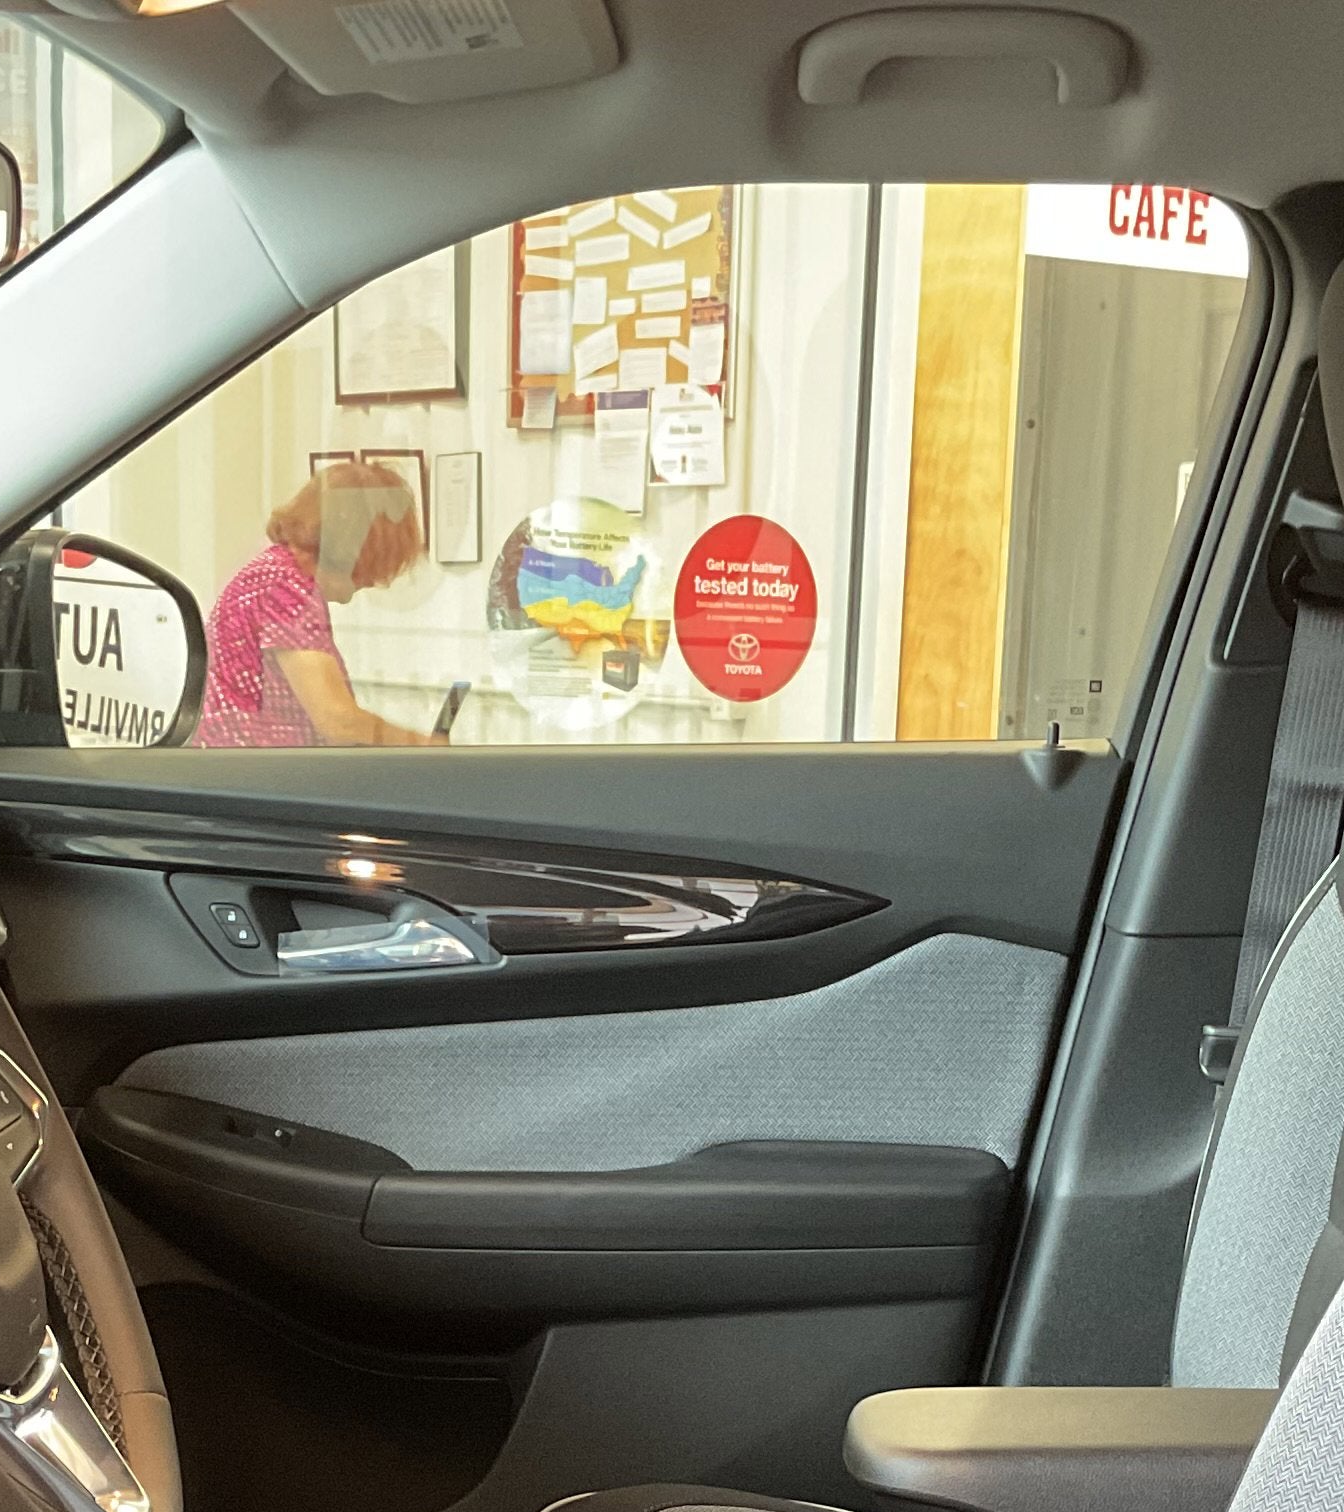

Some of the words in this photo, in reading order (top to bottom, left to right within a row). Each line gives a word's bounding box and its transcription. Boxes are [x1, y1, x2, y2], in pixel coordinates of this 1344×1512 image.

[1109, 183, 1210, 245] CAFE
[705, 557, 725, 572] Get
[727, 561, 750, 575] your
[751, 560, 789, 577] battery
[694, 575, 748, 597] tested
[752, 577, 800, 603] today
[724, 663, 763, 675] TOYOTA
